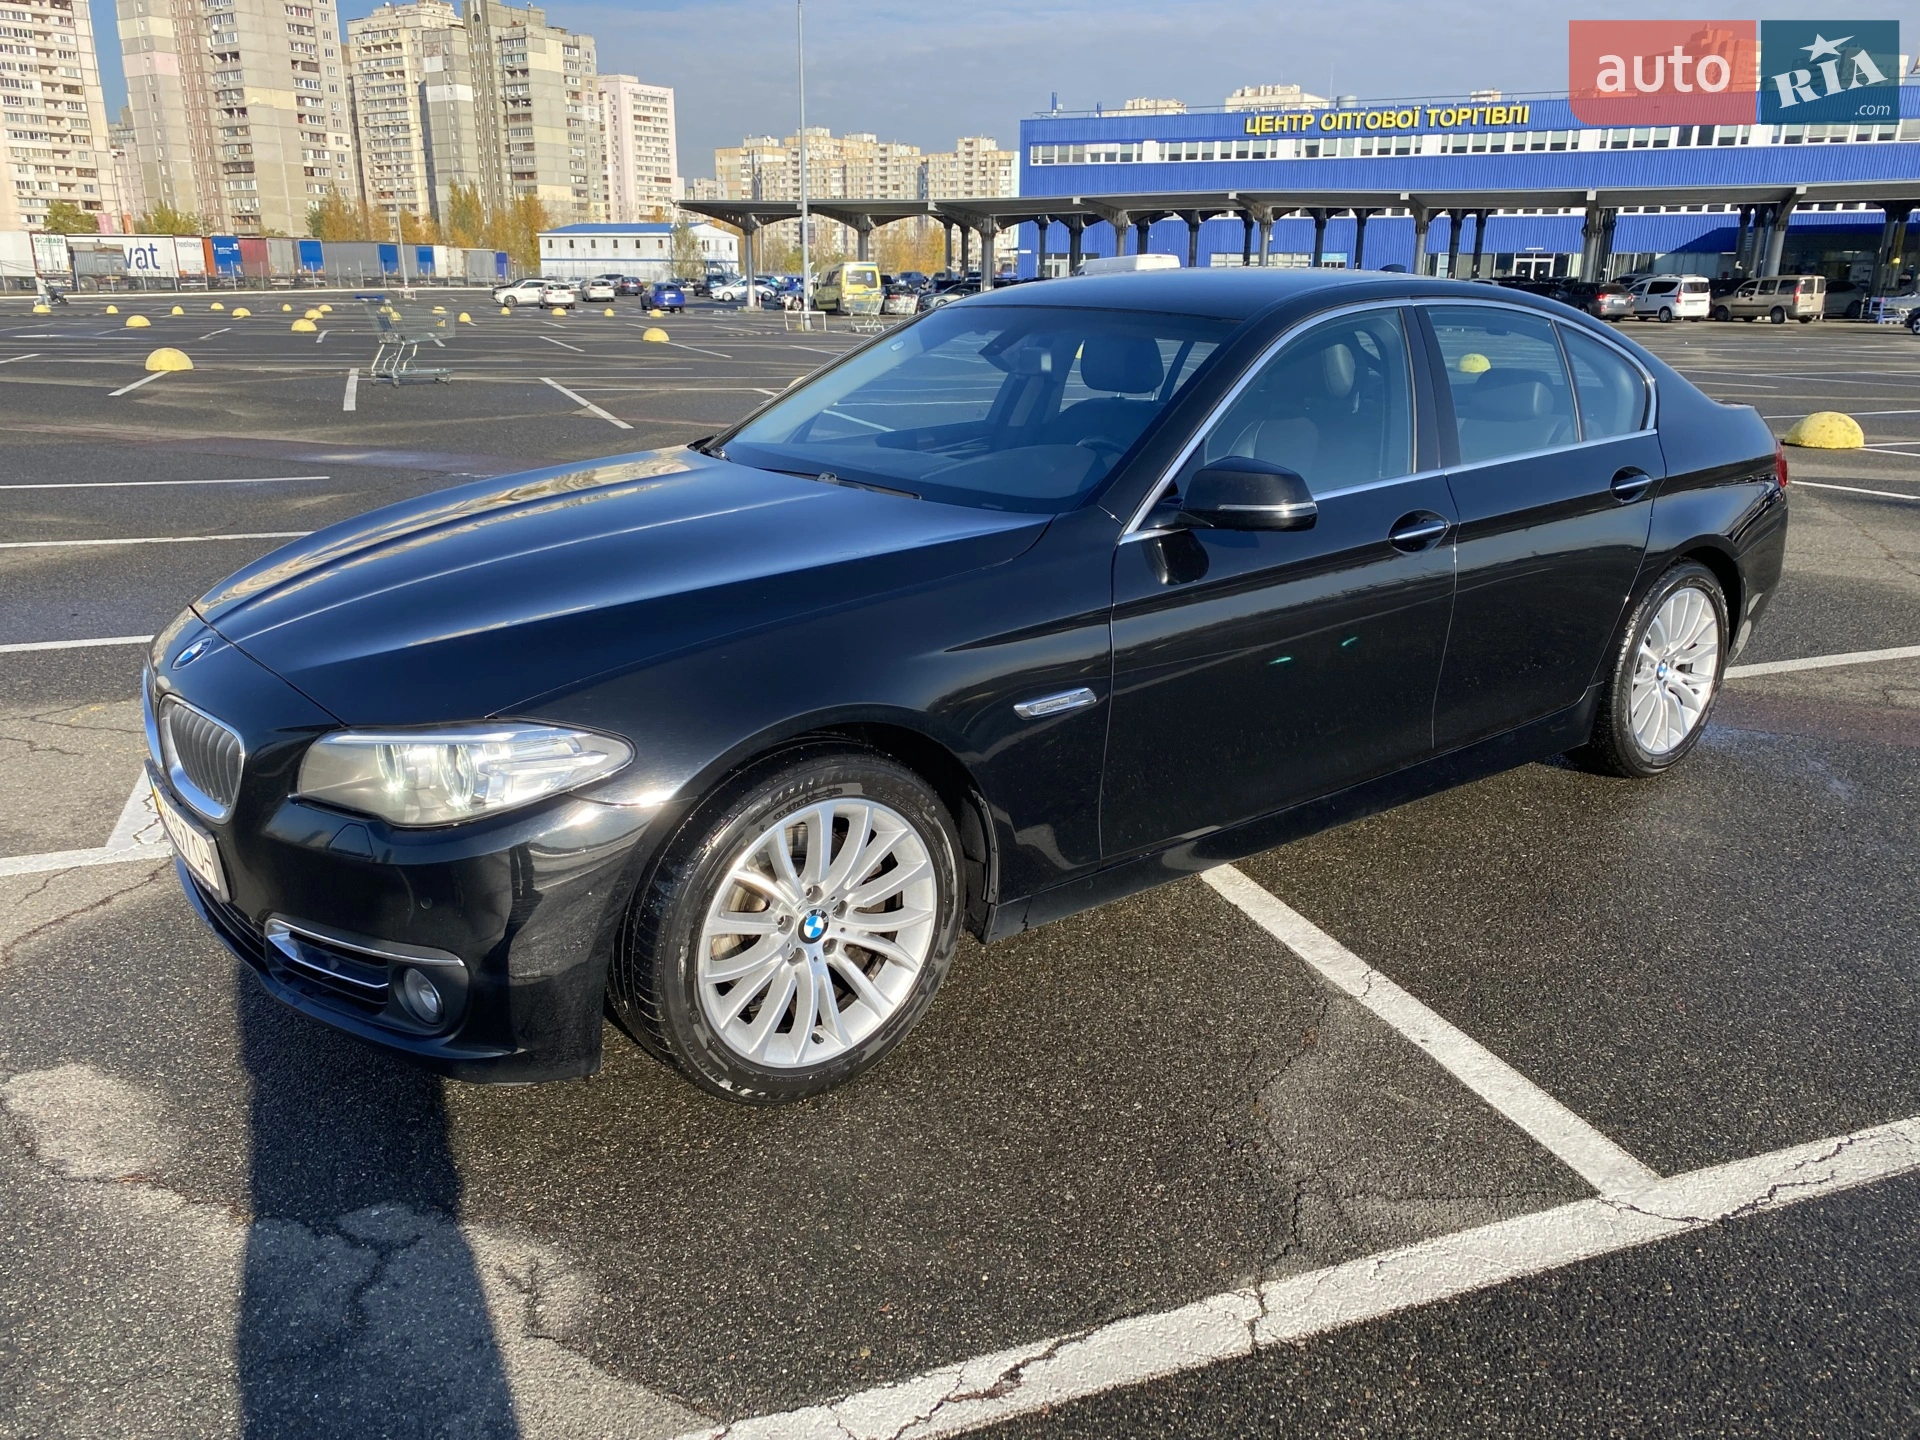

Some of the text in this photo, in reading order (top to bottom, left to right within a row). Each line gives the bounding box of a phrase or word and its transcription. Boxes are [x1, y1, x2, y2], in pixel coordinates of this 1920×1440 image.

[1246, 105, 1530, 135] ЦЕНТР ОПТОВОЇ ТОРГІВЛІ
